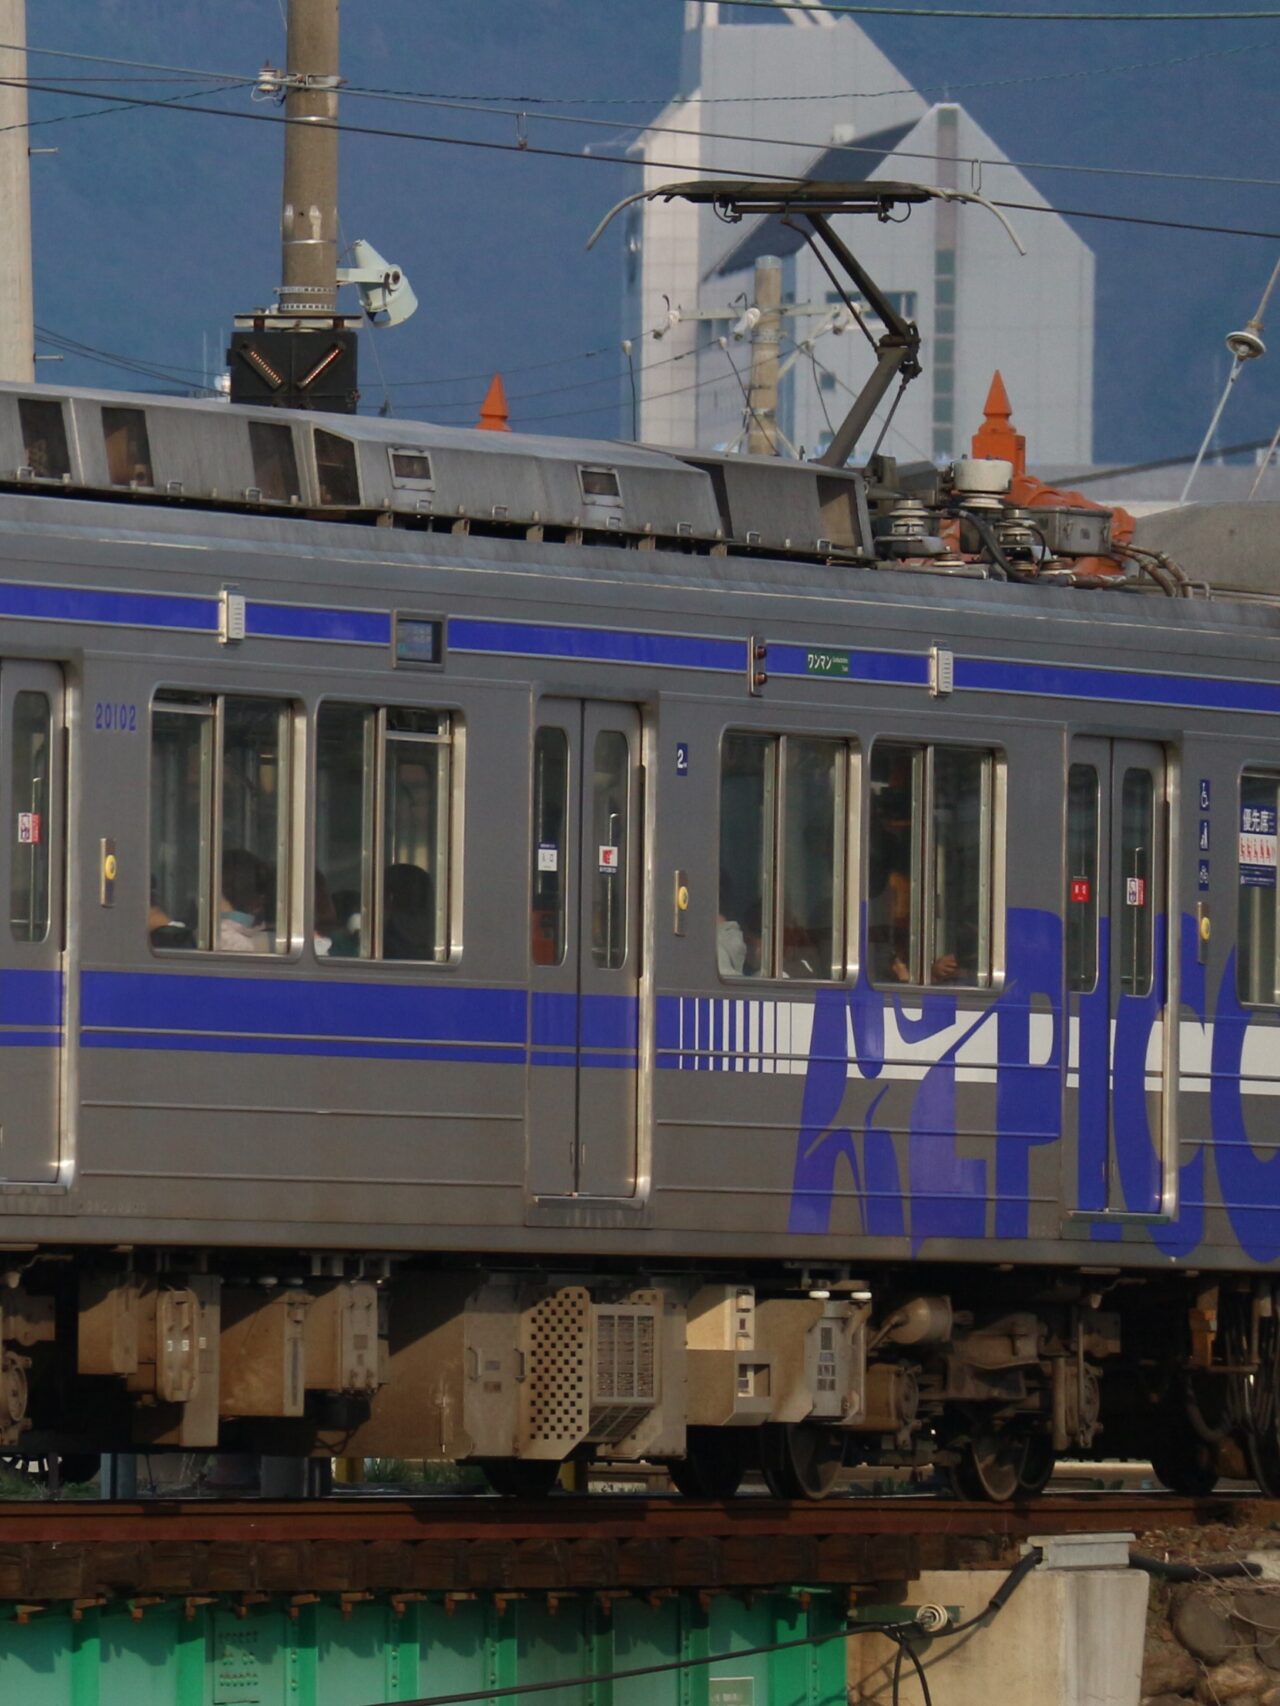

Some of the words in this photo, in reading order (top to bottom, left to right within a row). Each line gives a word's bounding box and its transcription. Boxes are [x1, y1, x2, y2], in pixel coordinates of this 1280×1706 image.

[807, 653, 832, 670] ワンマン
[95, 703, 136, 731] 20102
[1243, 808, 1269, 833] 優先席
